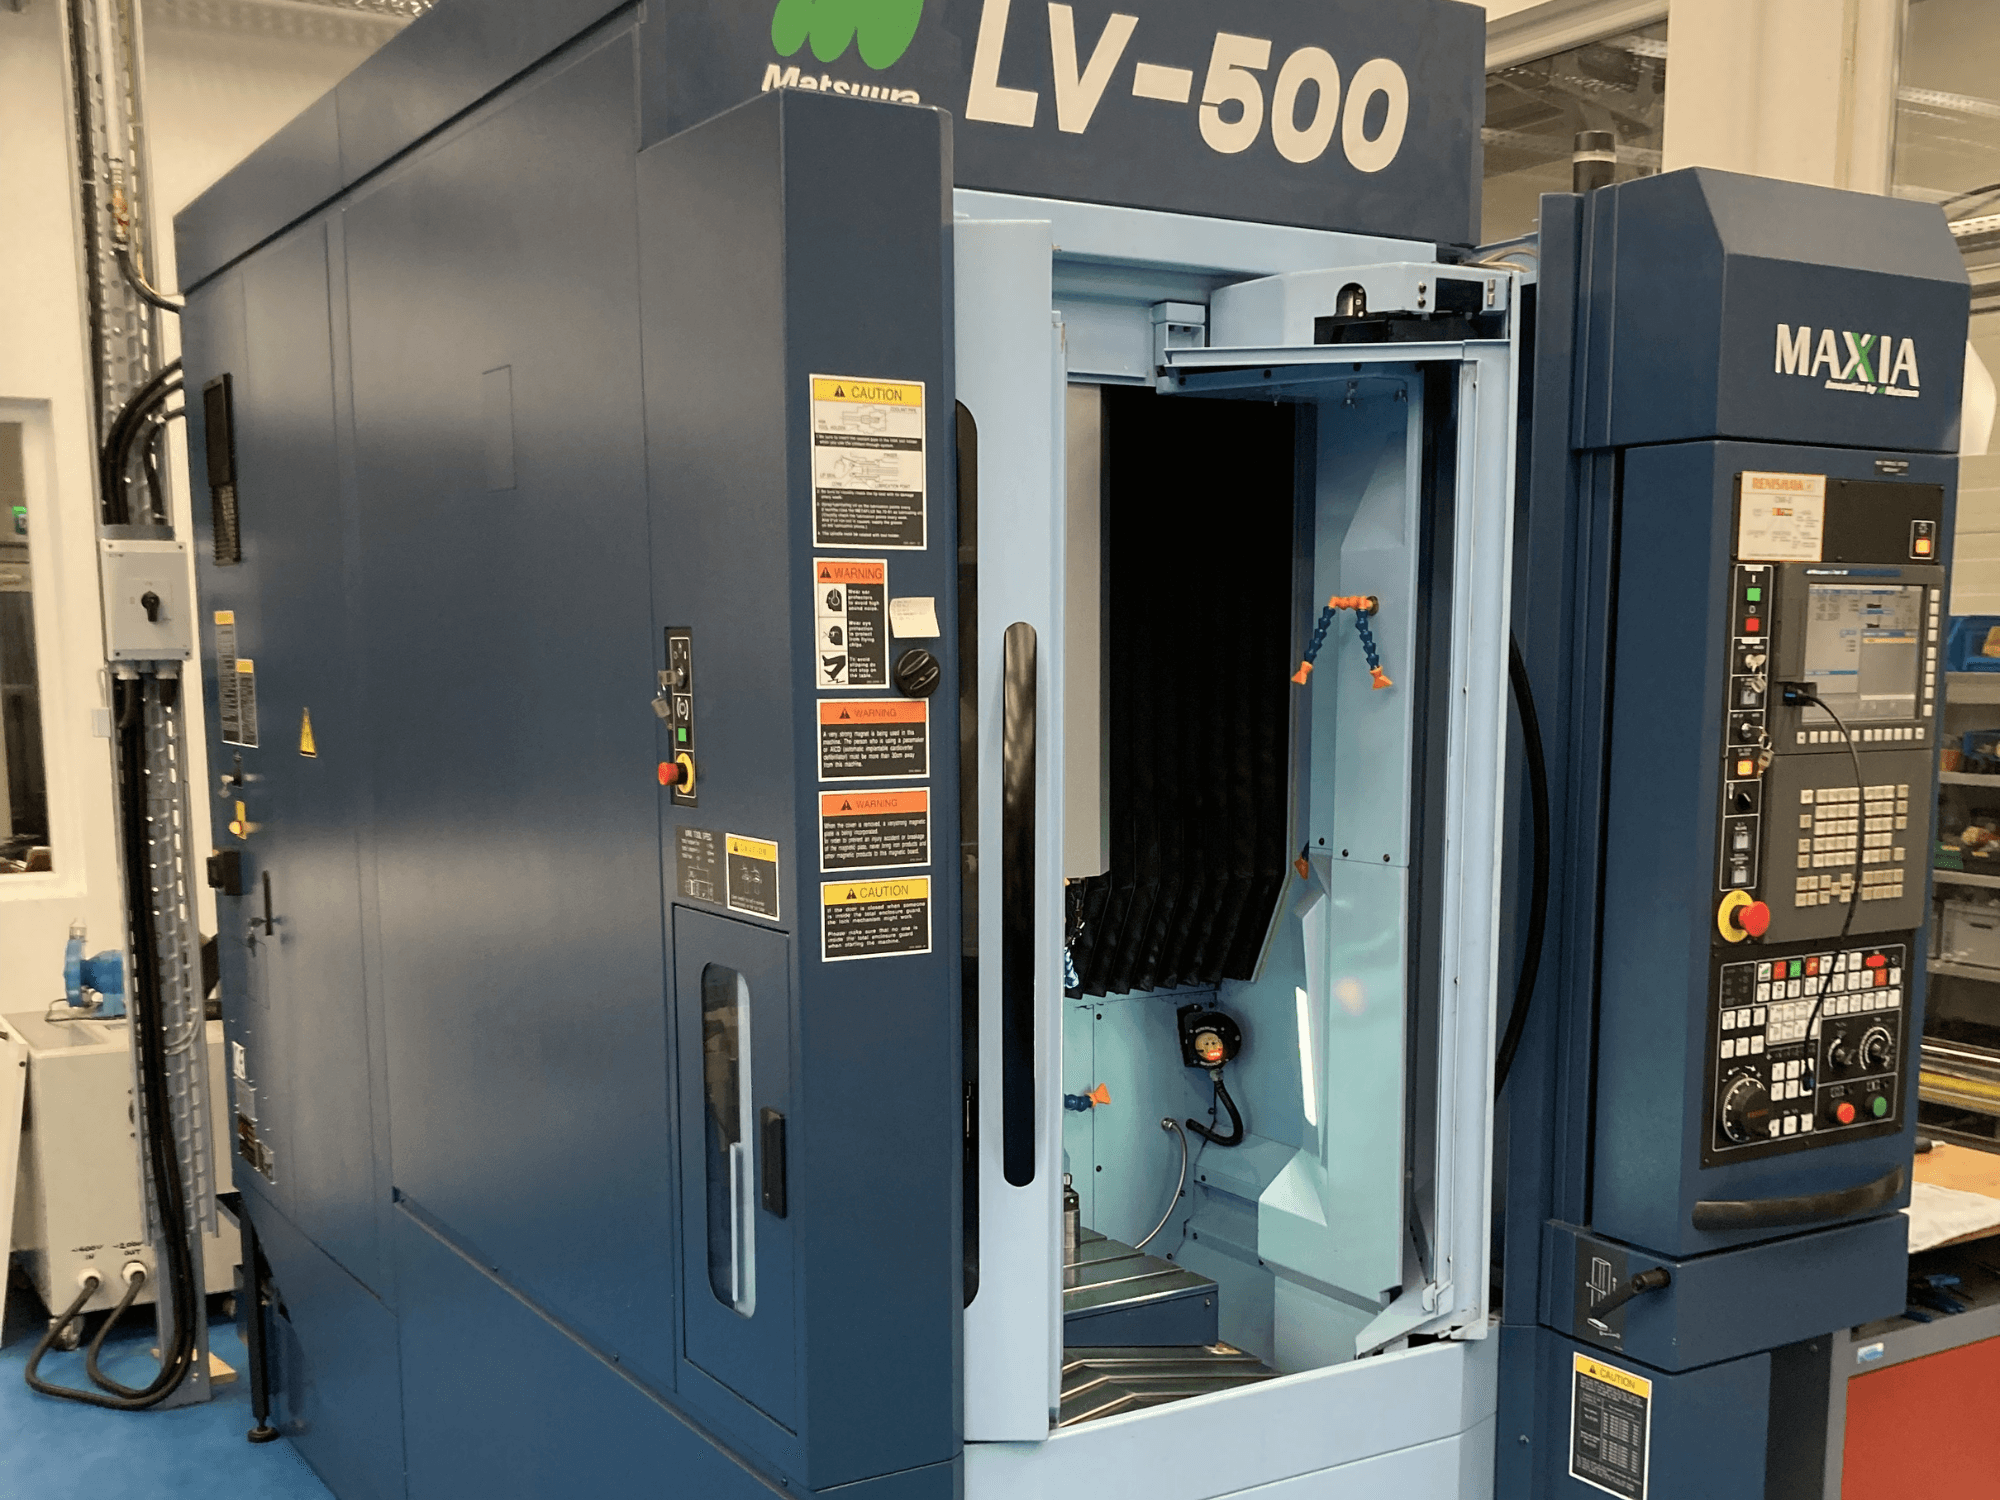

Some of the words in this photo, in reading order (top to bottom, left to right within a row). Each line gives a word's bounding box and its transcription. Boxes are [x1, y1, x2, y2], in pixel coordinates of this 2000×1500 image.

[966, 0, 1409, 173] LV-500
[1775, 323, 1920, 387] MAXIA
[852, 386, 902, 401] CAUTION
[834, 567, 882, 580] WARNING
[855, 708, 897, 717] WARNING
[856, 800, 898, 808] WARNING
[860, 885, 908, 898] CAUTION
[1600, 1368, 1635, 1390] CAUTION
